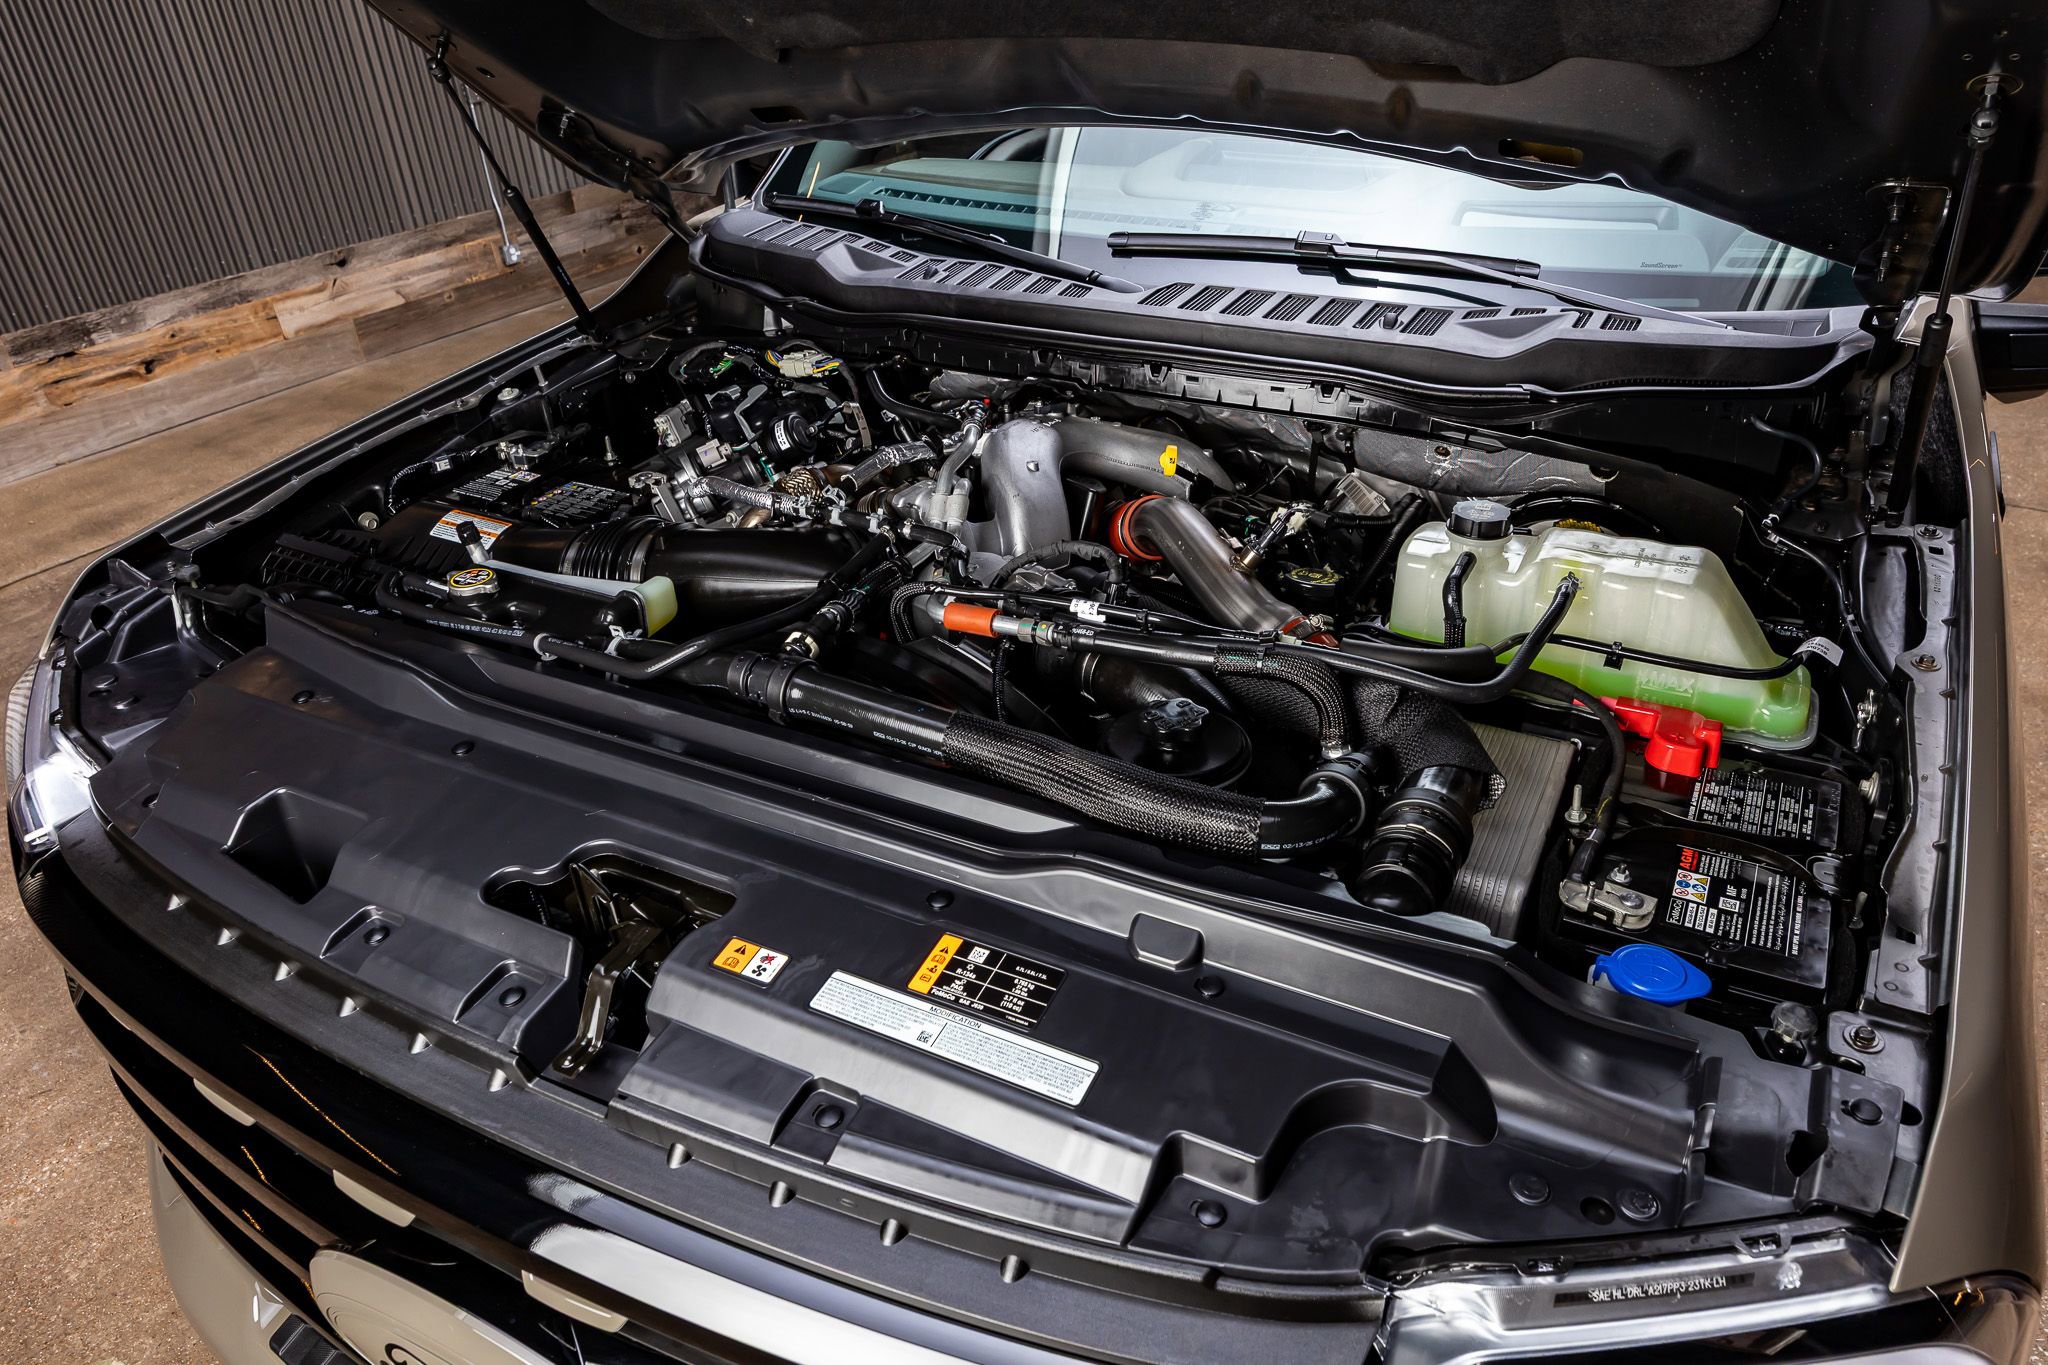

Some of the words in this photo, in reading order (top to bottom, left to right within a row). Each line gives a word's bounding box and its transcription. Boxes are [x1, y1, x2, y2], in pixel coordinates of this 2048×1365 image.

[1680, 848, 1694, 871] AGM
[1726, 885, 1737, 897] MF
[1669, 900, 1683, 924] FoMoCo
[956, 968, 976, 979] R-134a
[931, 989, 955, 1001] FoMoCo
[930, 1007, 982, 1029] MODIFICATION
[1592, 1290, 1611, 1302] SAE
[1613, 1288, 1625, 1300] HL
[1627, 1285, 1646, 1299] DRL
[1713, 1276, 1727, 1288] LH
